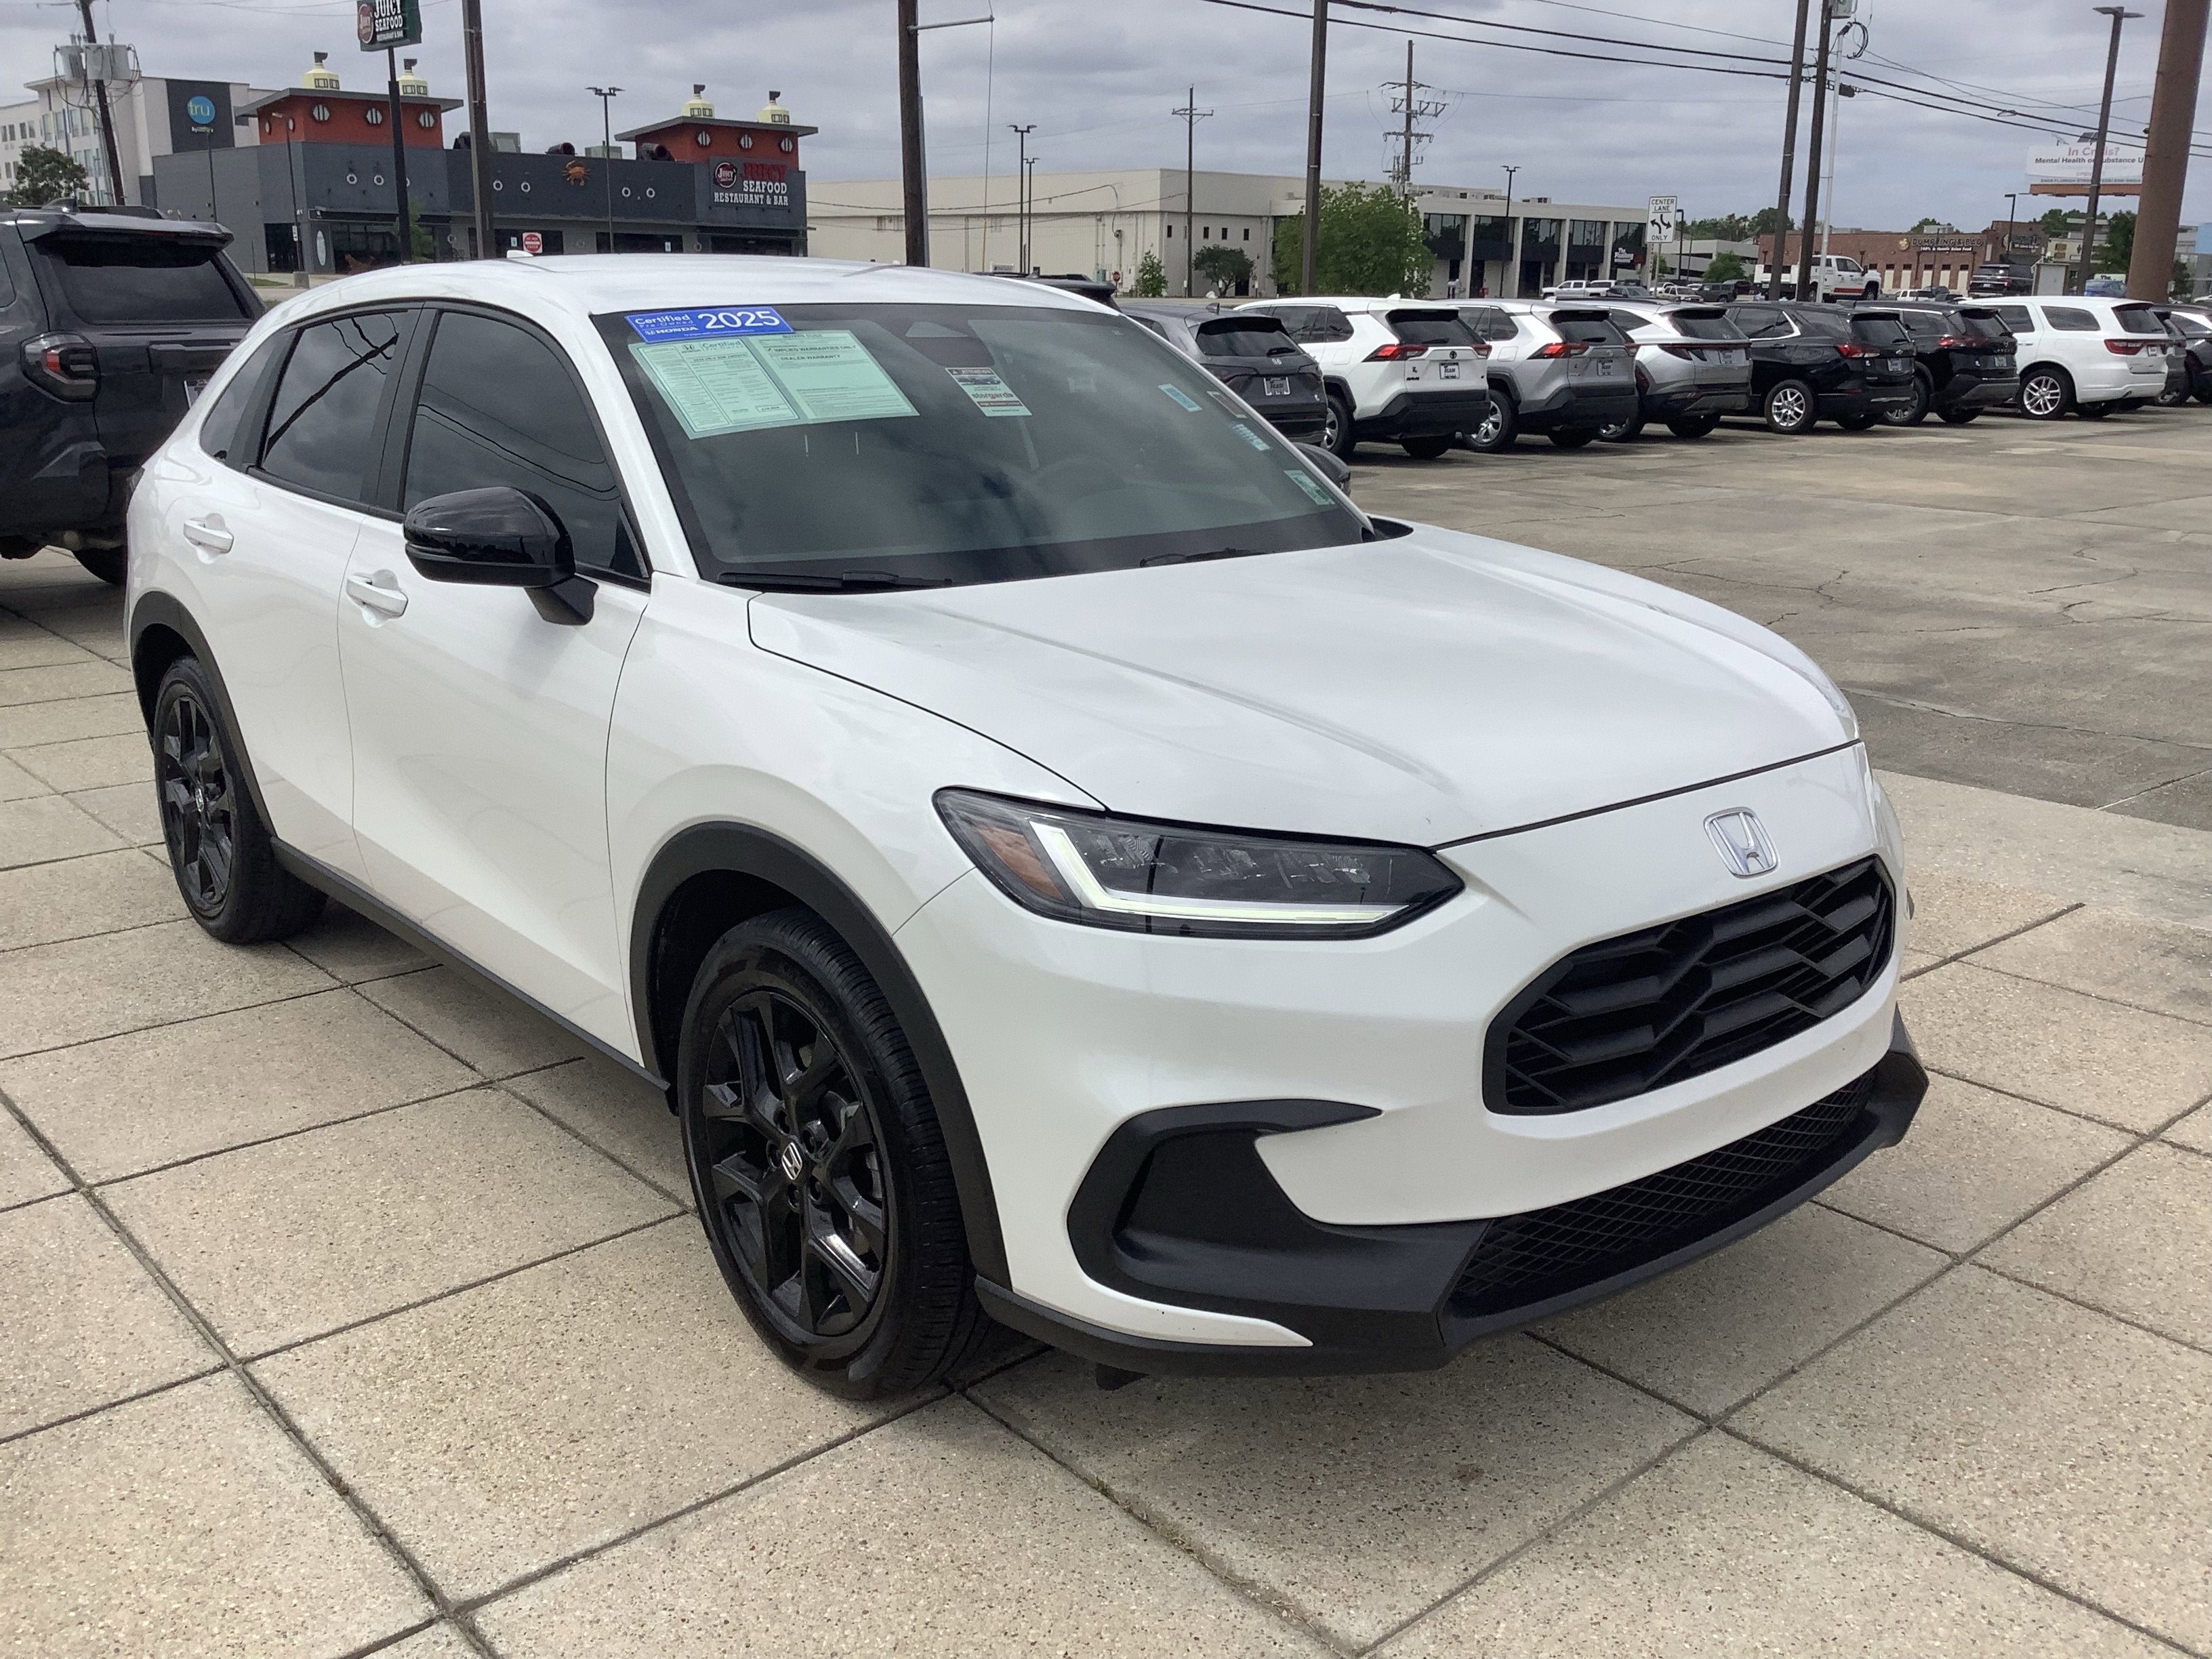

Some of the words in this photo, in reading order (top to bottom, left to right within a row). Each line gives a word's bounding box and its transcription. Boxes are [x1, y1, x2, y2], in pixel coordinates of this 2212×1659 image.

[374, 0, 401, 18] JUICY
[375, 15, 403, 31] SEAFOOD
[188, 101, 210, 116] tru
[2068, 147, 2078, 156] In
[2082, 146, 2120, 157] Cris?
[743, 180, 787, 194] SEAFOOD
[714, 192, 764, 205] RESTAURANT
[766, 194, 772, 205] &
[773, 194, 789, 206] BAR
[1965, 238, 1982, 246] BAO
[635, 314, 691, 325] Certified
[697, 310, 780, 329] 2025
[702, 340, 741, 348] Certified
